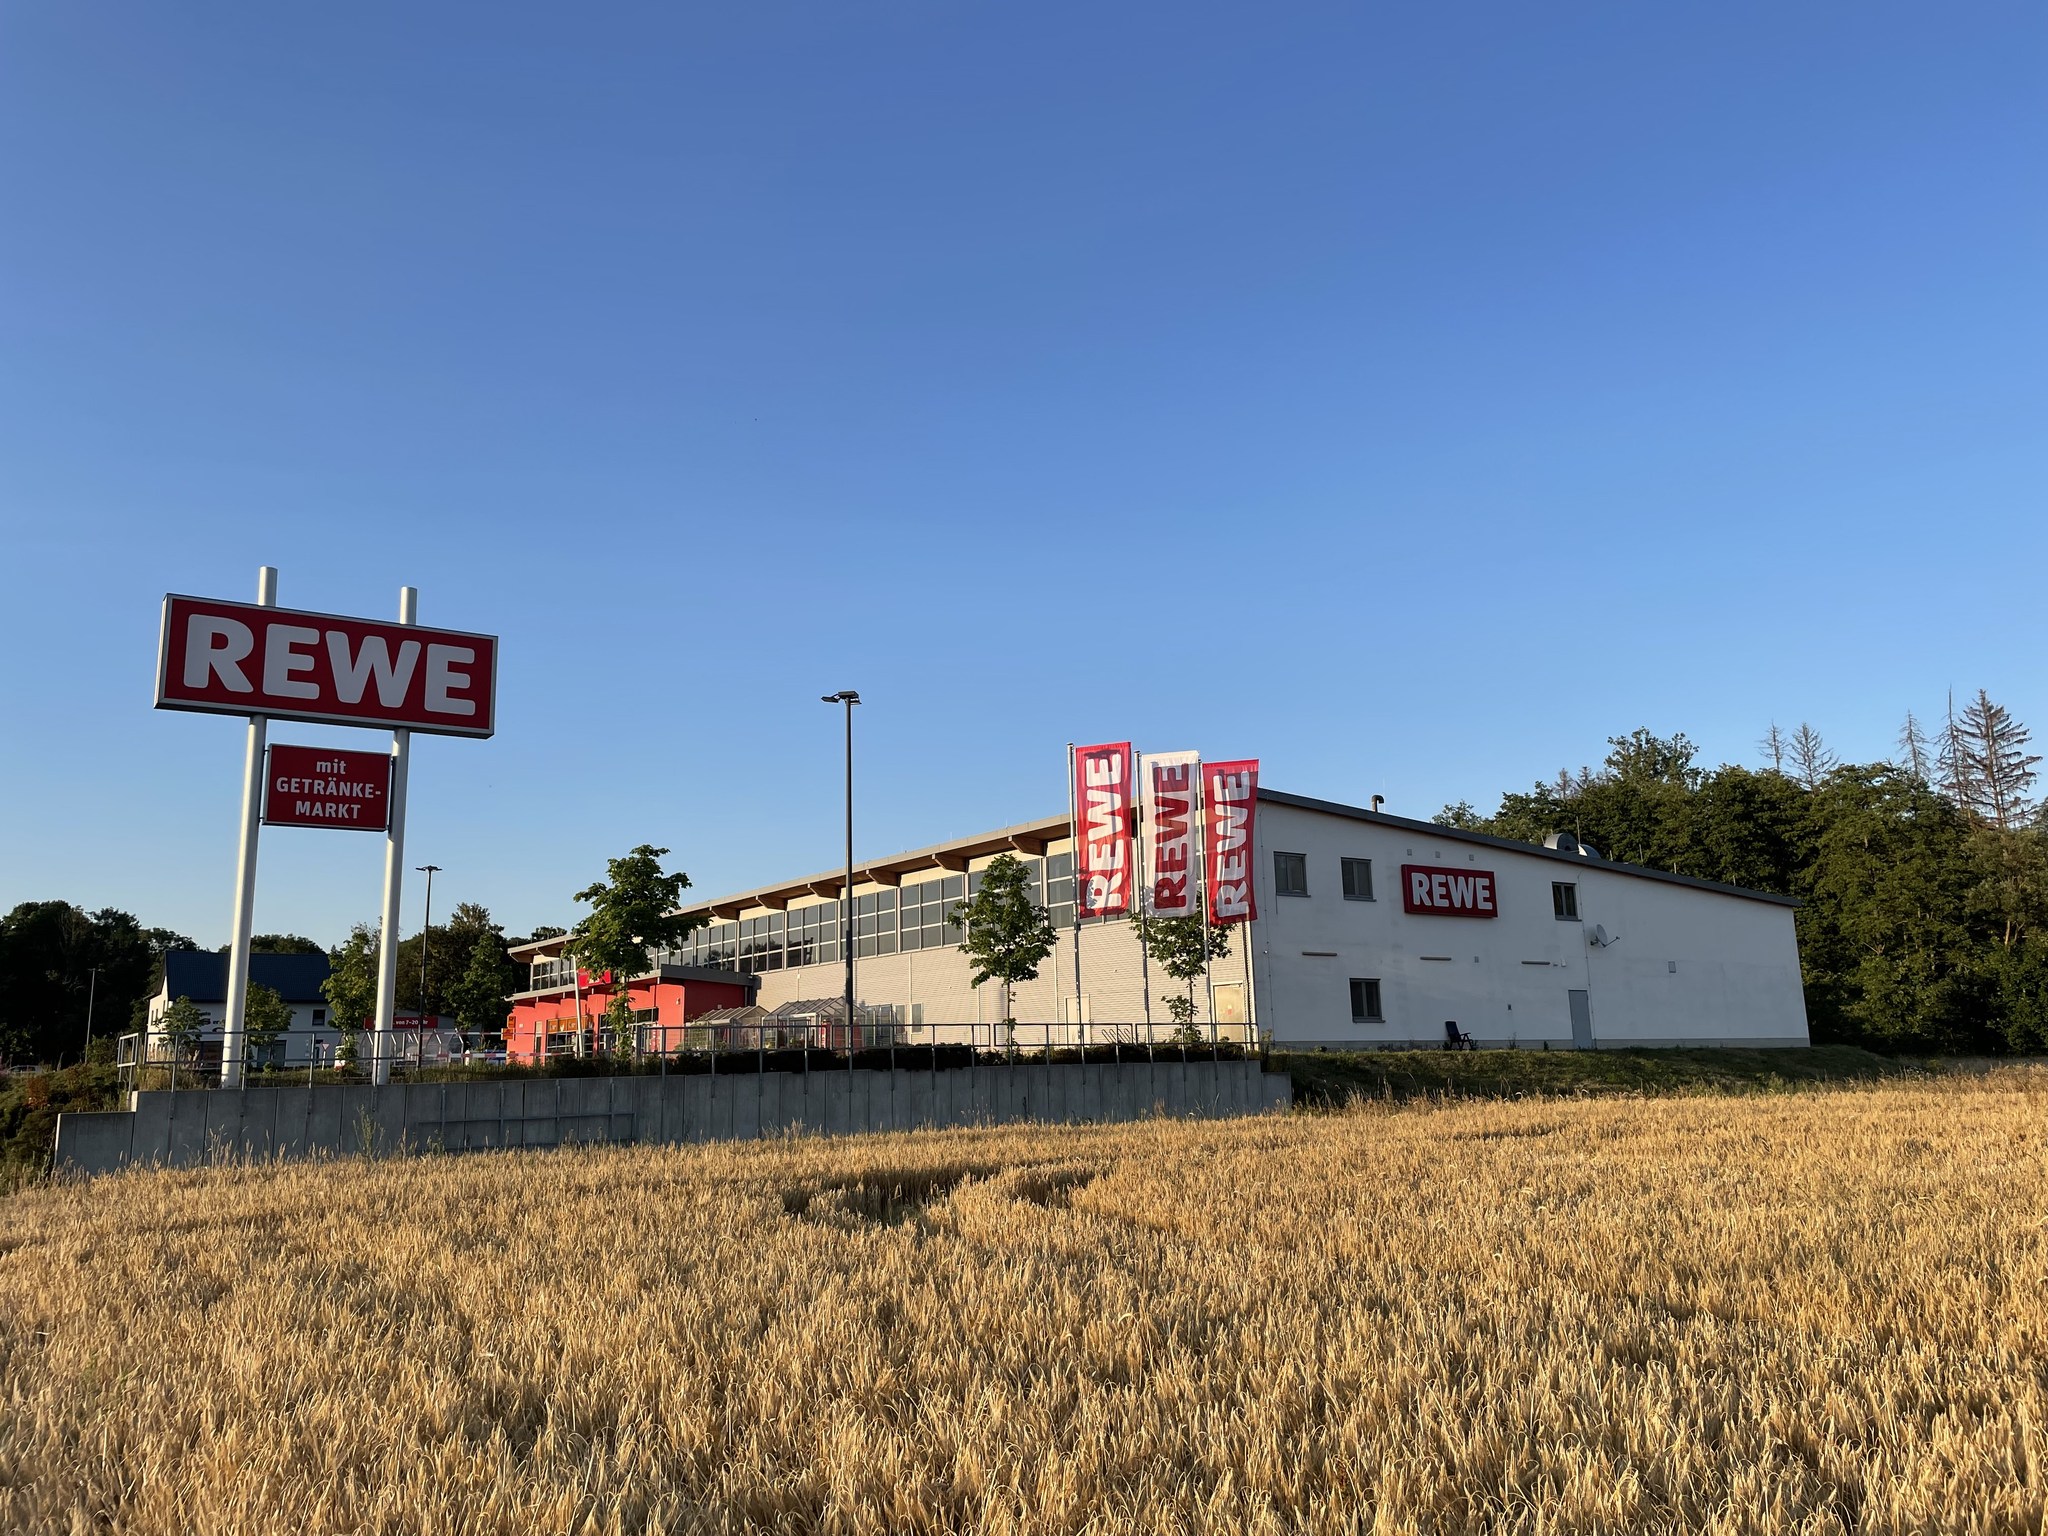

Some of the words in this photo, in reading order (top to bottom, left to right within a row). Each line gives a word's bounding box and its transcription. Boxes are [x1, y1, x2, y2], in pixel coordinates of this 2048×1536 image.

[183, 613, 476, 715] REWE
[276, 776, 381, 798] GETRÄNKE-
[316, 758, 346, 775] mit
[295, 800, 361, 819] MARKT
[1086, 754, 1123, 909] REWE
[1153, 762, 1189, 909] REWE
[1213, 771, 1250, 917] REWE
[1411, 872, 1493, 910] REWE
